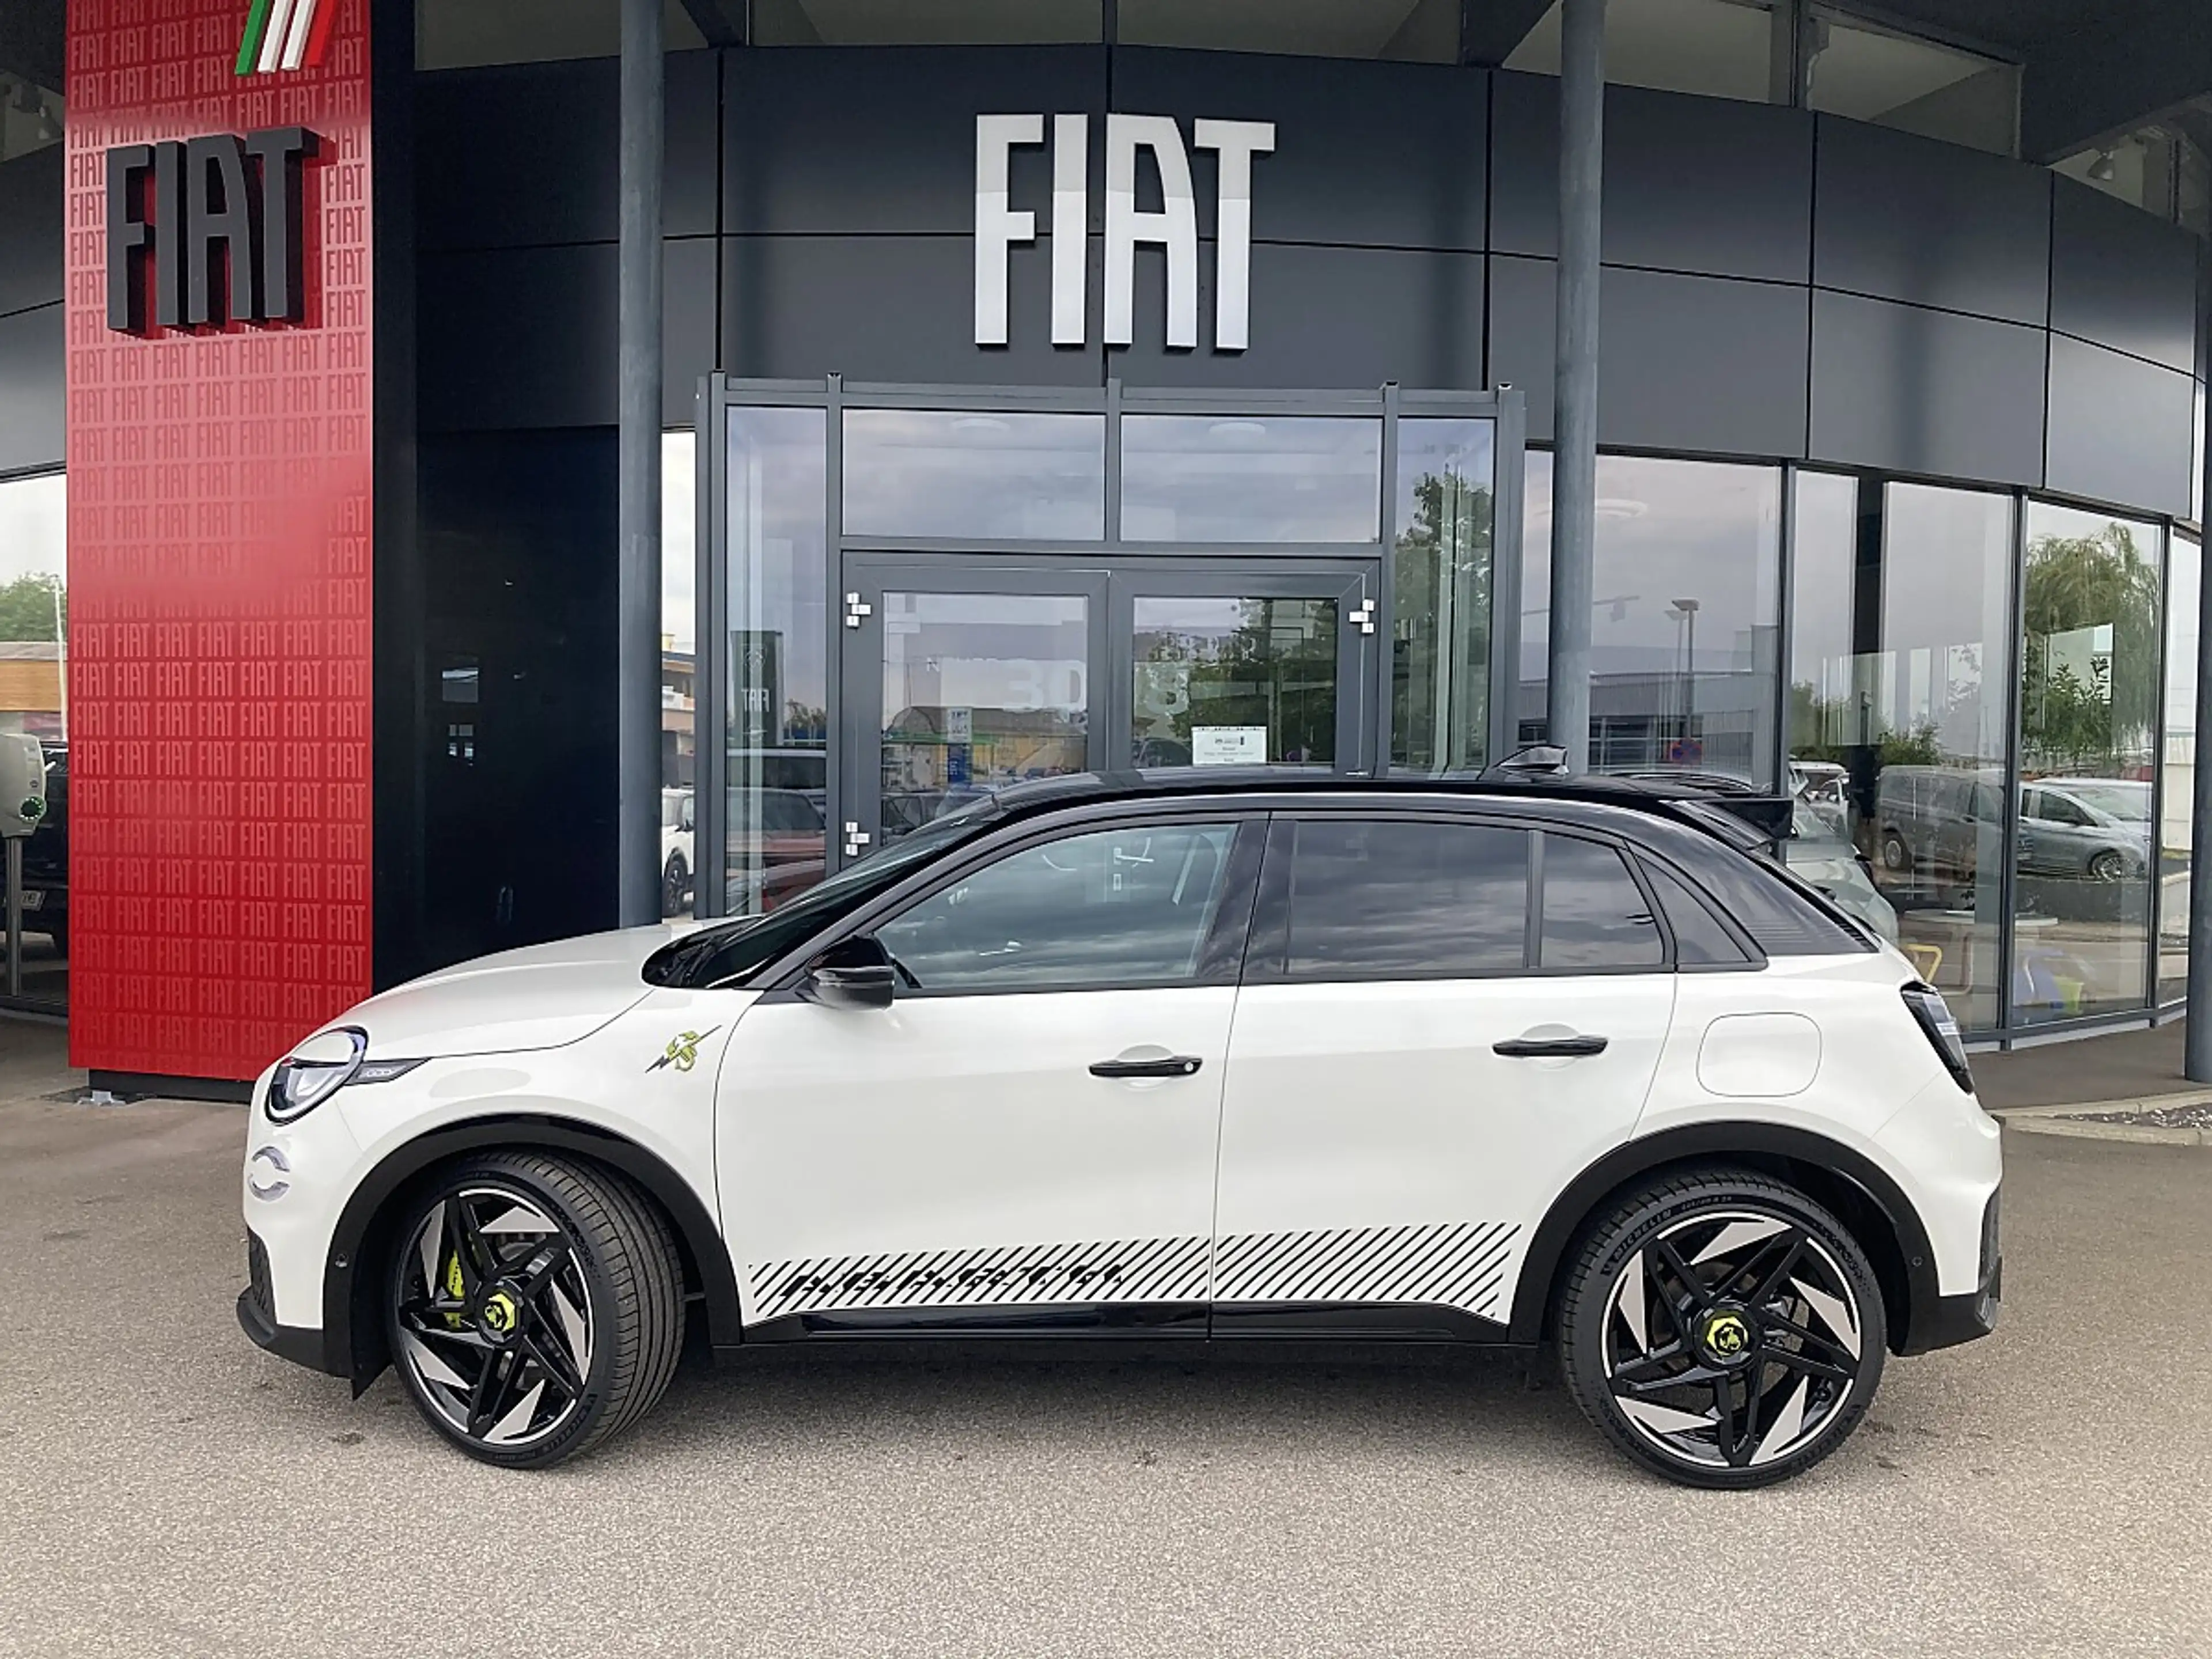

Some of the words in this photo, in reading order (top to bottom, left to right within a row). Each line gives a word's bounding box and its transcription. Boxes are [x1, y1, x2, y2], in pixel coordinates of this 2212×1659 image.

[69, 0, 105, 32] FIAT
[70, 32, 105, 71] FIAT
[111, 26, 147, 66] FIAT
[151, 21, 189, 60] FIAT
[194, 15, 232, 55] FIAT
[70, 71, 105, 110] FIAT
[111, 67, 147, 105] FIAT
[152, 61, 189, 101] FIAT
[194, 56, 232, 96] FIAT
[237, 92, 275, 131] FIAT
[281, 86, 320, 127] FIAT
[325, 81, 365, 122] FIAT
[71, 151, 106, 188] FIAT
[339, 123, 365, 163] IAT
[71, 190, 107, 228] FIAT
[326, 165, 365, 205] FIAT
[71, 230, 107, 267] FIAT
[326, 206, 365, 246] FIAT
[107, 126, 304, 329] FIAT
[975, 113, 1275, 349] FIAT
[71, 269, 107, 306] FIAT
[326, 248, 366, 287] FIAT
[72, 309, 107, 345] FIAT
[326, 290, 366, 329] FIAT
[72, 348, 108, 384] FIAT
[112, 346, 149, 382] FIAT
[154, 343, 191, 380] FIAT
[196, 340, 233, 378] FIAT
[238, 338, 276, 376] FIAT
[282, 335, 321, 373] FIAT
[327, 331, 366, 370] FIAT
[72, 387, 108, 423] FIAT
[113, 385, 149, 422] FIAT
[154, 383, 191, 420] FIAT
[196, 381, 233, 418] FIAT
[238, 378, 276, 416] FIAT
[282, 376, 321, 414] FIAT
[327, 373, 366, 411] FIAT
[73, 427, 108, 462] FIAT
[113, 425, 149, 461] FIAT
[154, 423, 191, 460] FIAT
[196, 421, 233, 458] FIAT
[239, 419, 277, 456] FIAT
[282, 416, 321, 454] FIAT
[327, 414, 366, 452] FIAT
[73, 466, 108, 501] FIAT
[113, 465, 149, 500] FIAT
[154, 463, 191, 499] FIAT
[196, 461, 233, 498] FIAT
[73, 505, 108, 540] FIAT
[113, 504, 149, 540] FIAT
[154, 503, 191, 539] FIAT
[196, 502, 234, 538] FIAT
[327, 538, 366, 575] FIAT
[327, 579, 366, 616] FIAT
[73, 623, 109, 657] FIAT
[113, 623, 150, 657] FIAT
[155, 623, 191, 657] FIAT
[196, 622, 234, 657] FIAT
[240, 622, 277, 657] FIAT
[283, 621, 321, 657] FIAT
[327, 620, 366, 657] FIAT
[74, 662, 109, 696] FIAT
[114, 662, 150, 697] FIAT
[155, 662, 191, 697] FIAT
[197, 662, 234, 698] FIAT
[240, 662, 277, 698] FIAT
[283, 662, 321, 698] FIAT
[327, 661, 366, 697] FIAT
[74, 700, 109, 736] FIAT
[114, 702, 150, 736] FIAT
[155, 702, 192, 737] FIAT
[197, 702, 234, 737] FIAT
[240, 702, 277, 738] FIAT
[283, 702, 321, 738] FIAT
[327, 702, 366, 738] FIAT
[74, 740, 109, 775] FIAT
[114, 741, 150, 775] FIAT
[155, 741, 192, 777] FIAT
[197, 742, 234, 777] FIAT
[240, 743, 277, 778] FIAT
[283, 743, 321, 778] FIAT
[327, 743, 366, 779] FIAT
[74, 778, 109, 813] FIAT
[114, 779, 150, 815] FIAT
[155, 781, 192, 816] FIAT
[197, 782, 234, 817] FIAT
[240, 782, 277, 818] FIAT
[283, 783, 321, 819] FIAT
[327, 783, 366, 819] FIAT
[74, 817, 109, 853] FIAT
[114, 819, 150, 854] FIAT
[156, 820, 192, 855] FIAT
[197, 821, 234, 857] FIAT
[240, 822, 277, 858] FIAT
[283, 823, 321, 859] FIAT
[327, 824, 366, 860] FIAT
[74, 856, 109, 892] FIAT
[115, 858, 150, 893] FIAT
[156, 859, 192, 895] FIAT
[197, 861, 234, 897] FIAT
[240, 862, 277, 898] FIAT
[283, 863, 321, 899] FIAT
[327, 864, 366, 900] FIAT
[74, 895, 109, 931] FIAT
[115, 897, 150, 933] FIAT
[156, 899, 192, 935] FIAT
[197, 900, 234, 937] FIAT
[240, 902, 277, 938] FIAT
[283, 903, 321, 940] FIAT
[327, 904, 366, 941] FIAT
[74, 934, 109, 969] FIAT
[115, 936, 150, 972] FIAT
[156, 938, 192, 974] FIAT
[197, 940, 234, 976] FIAT
[240, 942, 277, 978] FIAT
[283, 944, 321, 980] FIAT
[327, 945, 366, 981] FIAT
[115, 975, 150, 1012] FIAT
[156, 978, 192, 1014] FIAT
[197, 979, 234, 1016] FIAT
[240, 982, 277, 1018] FIAT
[283, 983, 321, 1020] FIAT
[1613, 1209, 1671, 1260] MICHELIN
